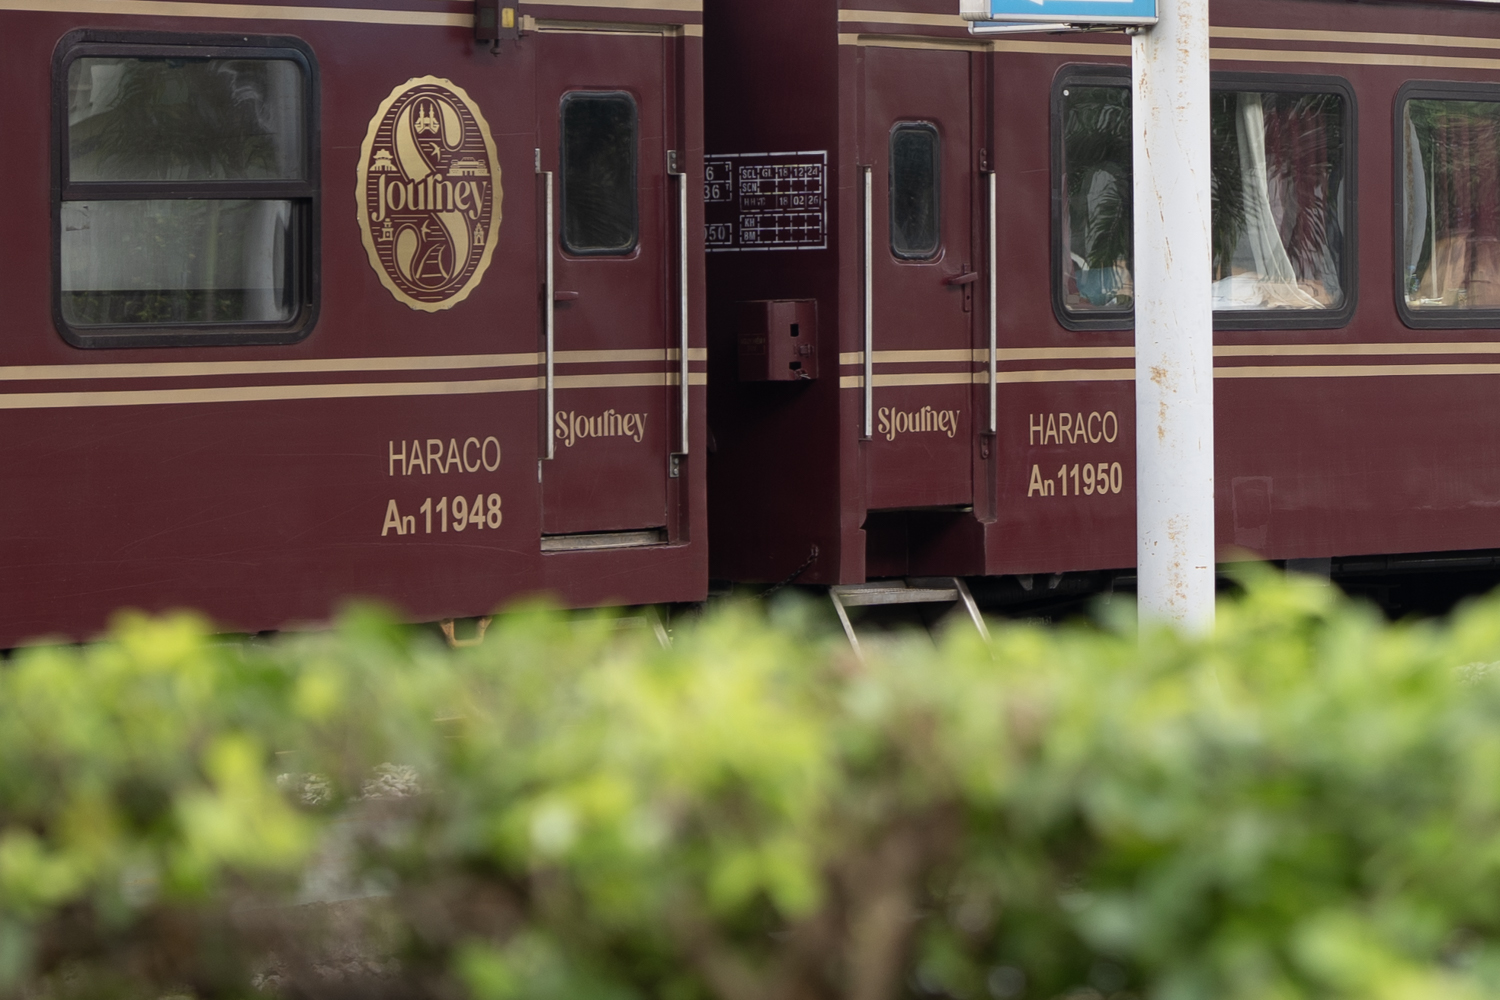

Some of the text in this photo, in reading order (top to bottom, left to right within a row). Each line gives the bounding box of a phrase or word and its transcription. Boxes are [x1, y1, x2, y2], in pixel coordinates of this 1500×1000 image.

[793, 168, 804, 177] 12
[793, 196, 804, 205] 02
[744, 217, 755, 227] KH
[1029, 411, 1118, 446] HARACO
[388, 436, 501, 476] HARACO
[1057, 461, 1123, 495] 11950
[419, 492, 503, 533] 11948
